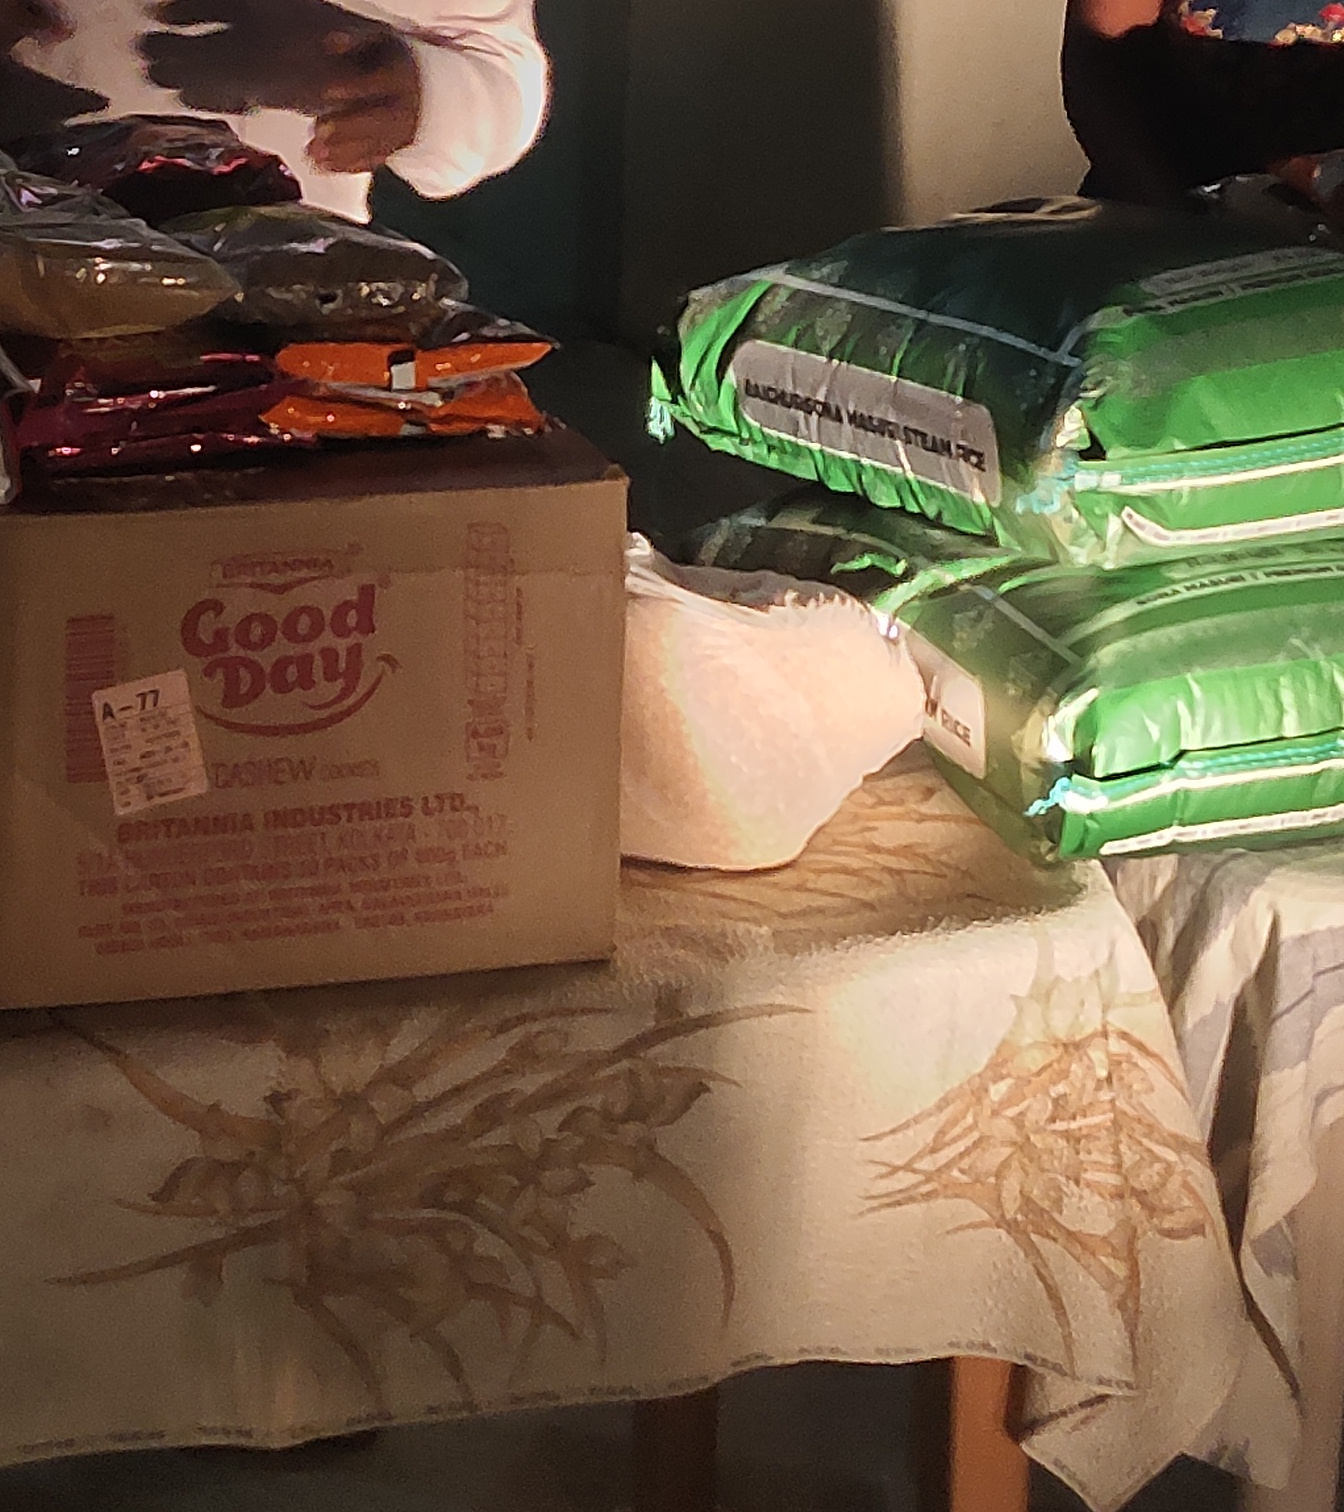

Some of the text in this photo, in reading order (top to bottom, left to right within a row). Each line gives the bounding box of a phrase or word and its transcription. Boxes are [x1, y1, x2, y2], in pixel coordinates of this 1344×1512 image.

[180, 583, 377, 659] Good
[201, 642, 364, 710] Day
[117, 811, 254, 845] BRITANNIA
[263, 794, 413, 831] INDUSTRIES
[462, 840, 506, 858] EACH
